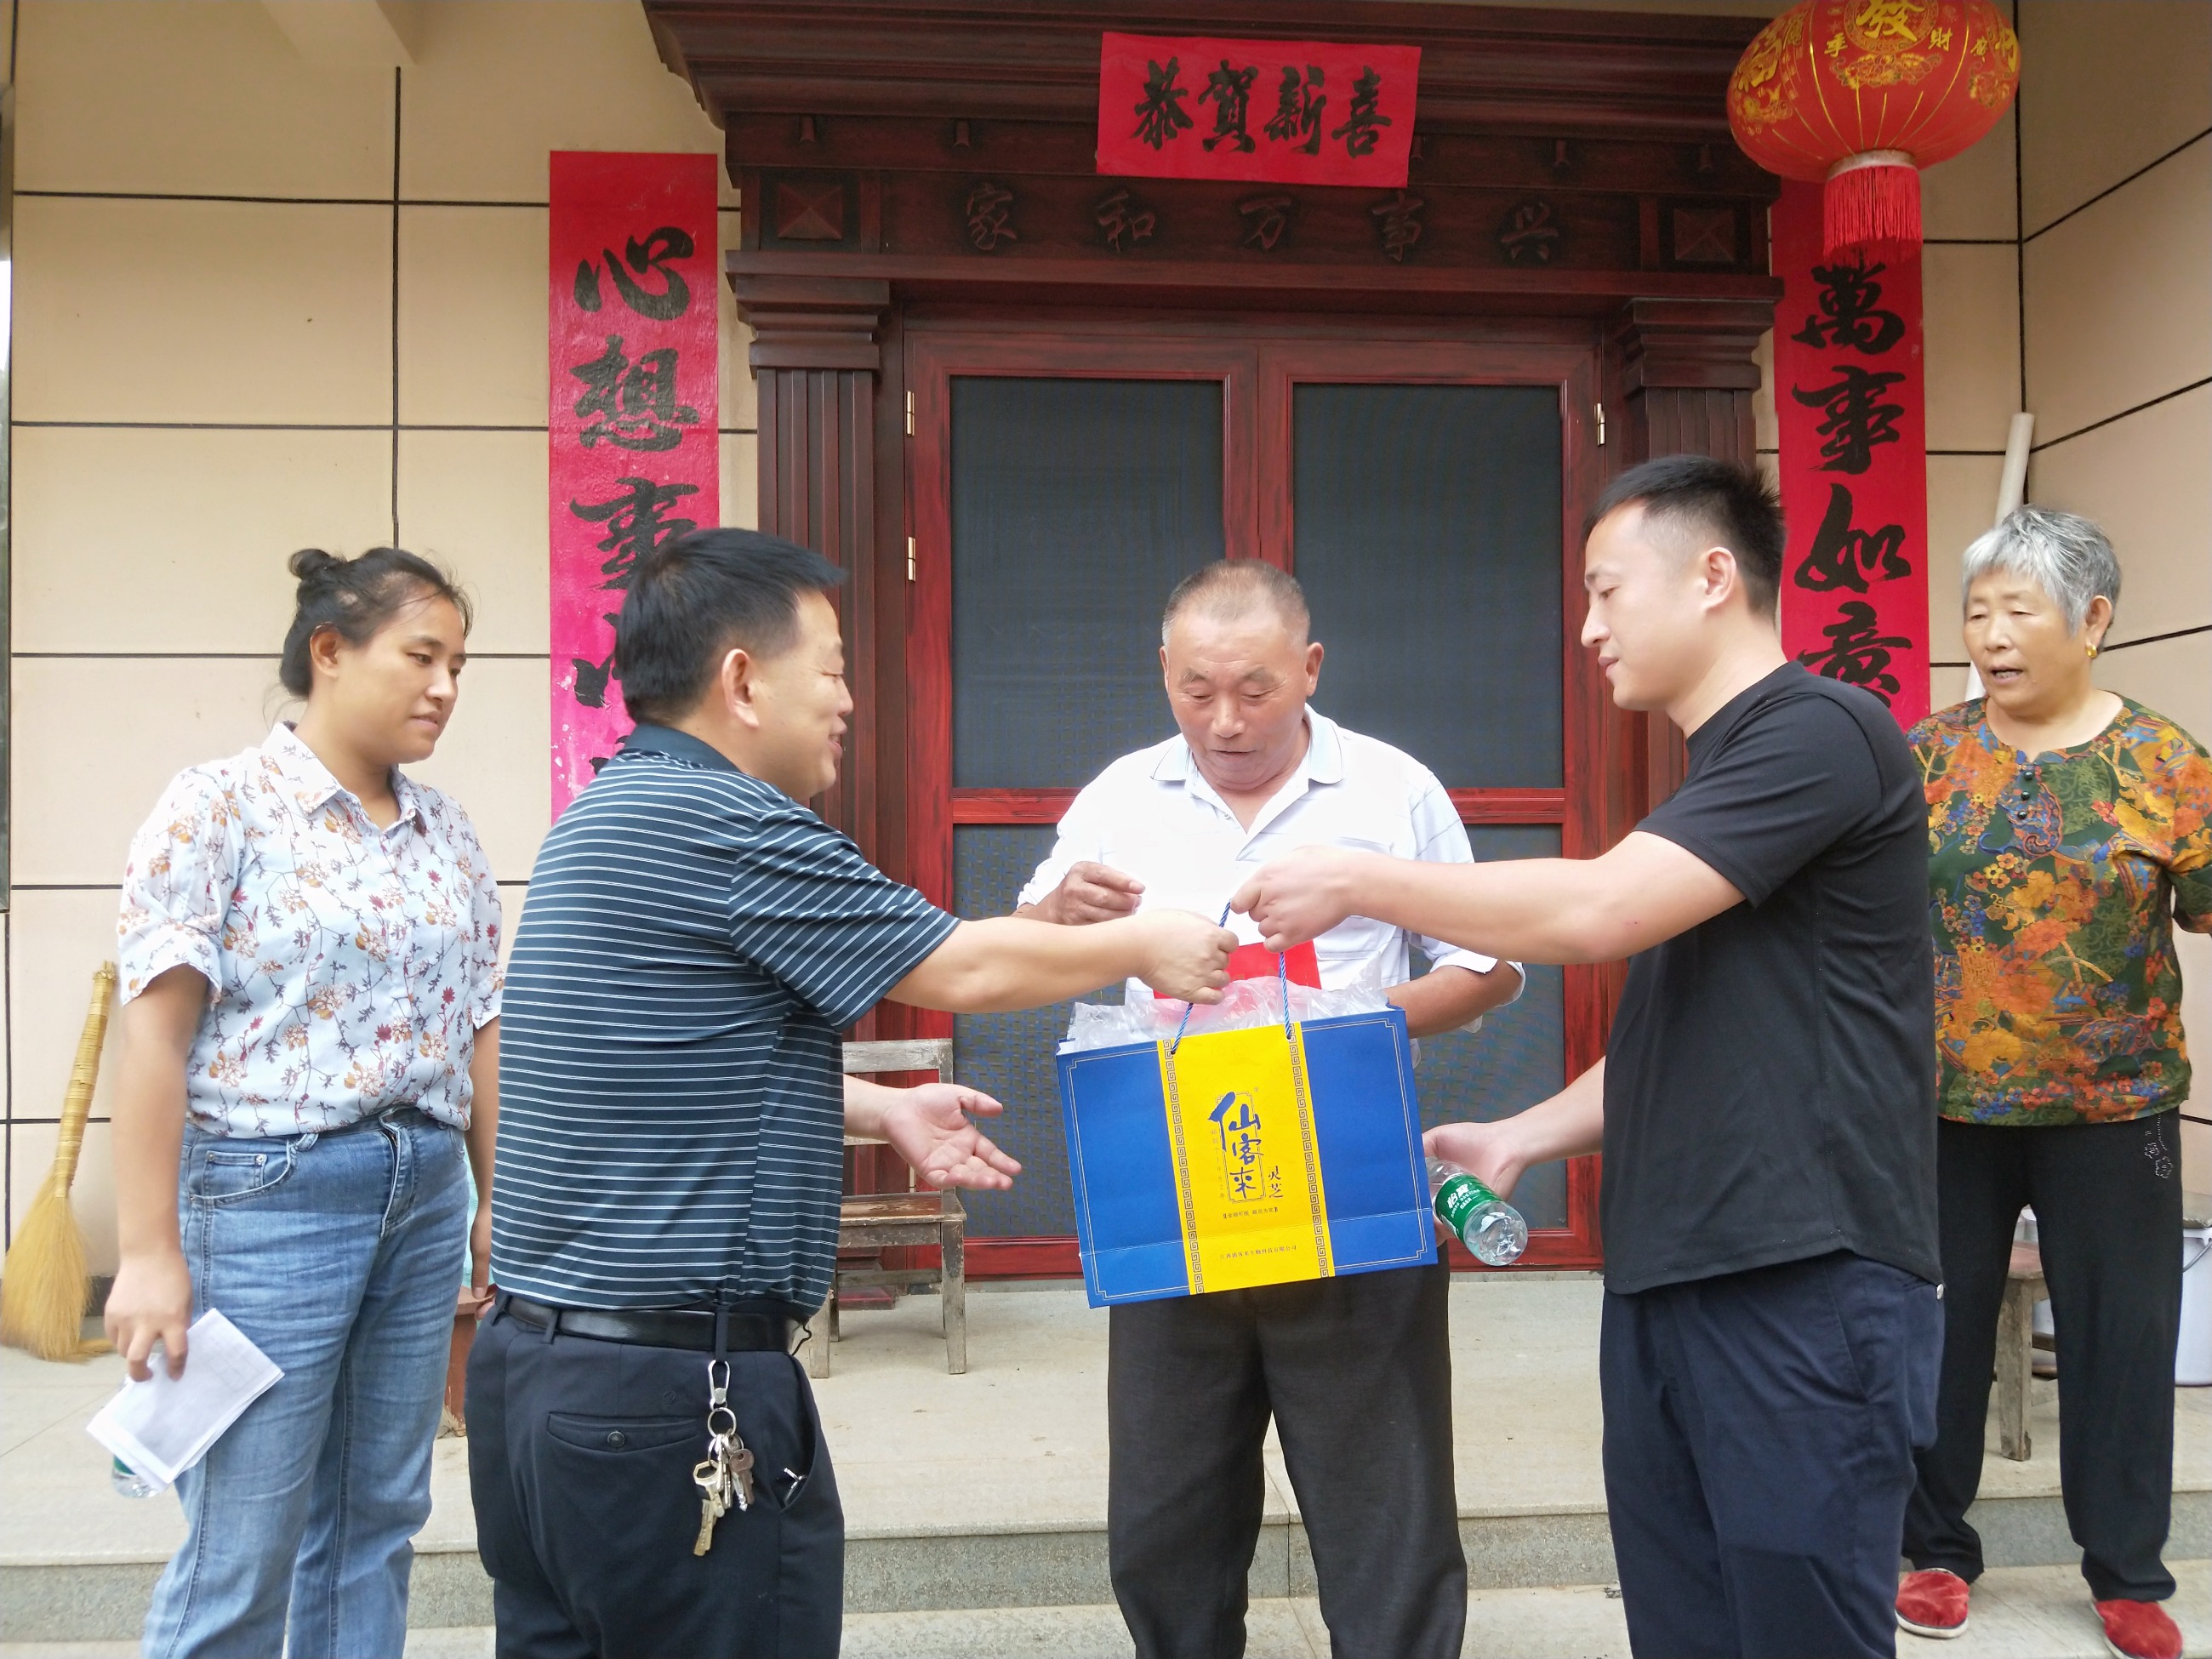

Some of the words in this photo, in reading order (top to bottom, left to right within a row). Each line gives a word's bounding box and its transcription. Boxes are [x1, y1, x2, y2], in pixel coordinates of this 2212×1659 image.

[1132, 56, 1393, 159] 恭賀新喜
[571, 225, 699, 775] 心想事
[1791, 254, 1913, 710] 萬事如意
[1268, 1165, 1284, 1199] 灵芝
